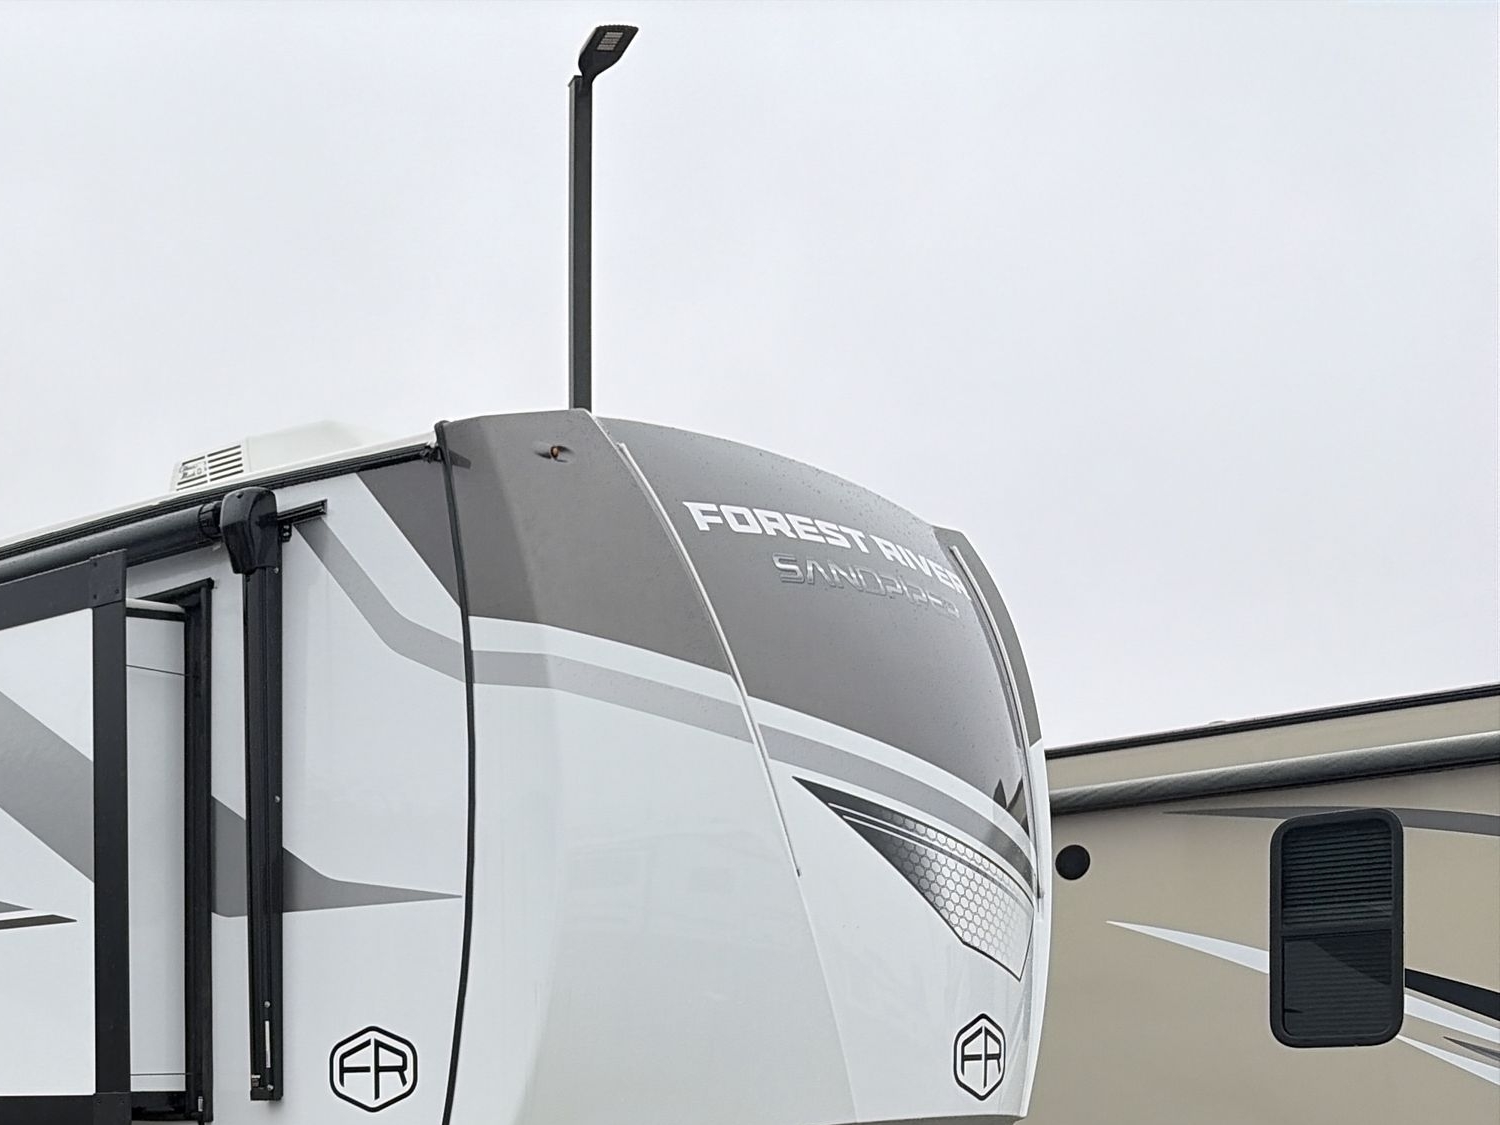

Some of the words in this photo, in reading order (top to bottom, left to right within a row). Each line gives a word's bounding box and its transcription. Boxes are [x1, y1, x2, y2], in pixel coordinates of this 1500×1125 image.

[682, 501, 870, 554] FOREST
[870, 534, 972, 600] RIVER
[339, 1037, 408, 1101] FR
